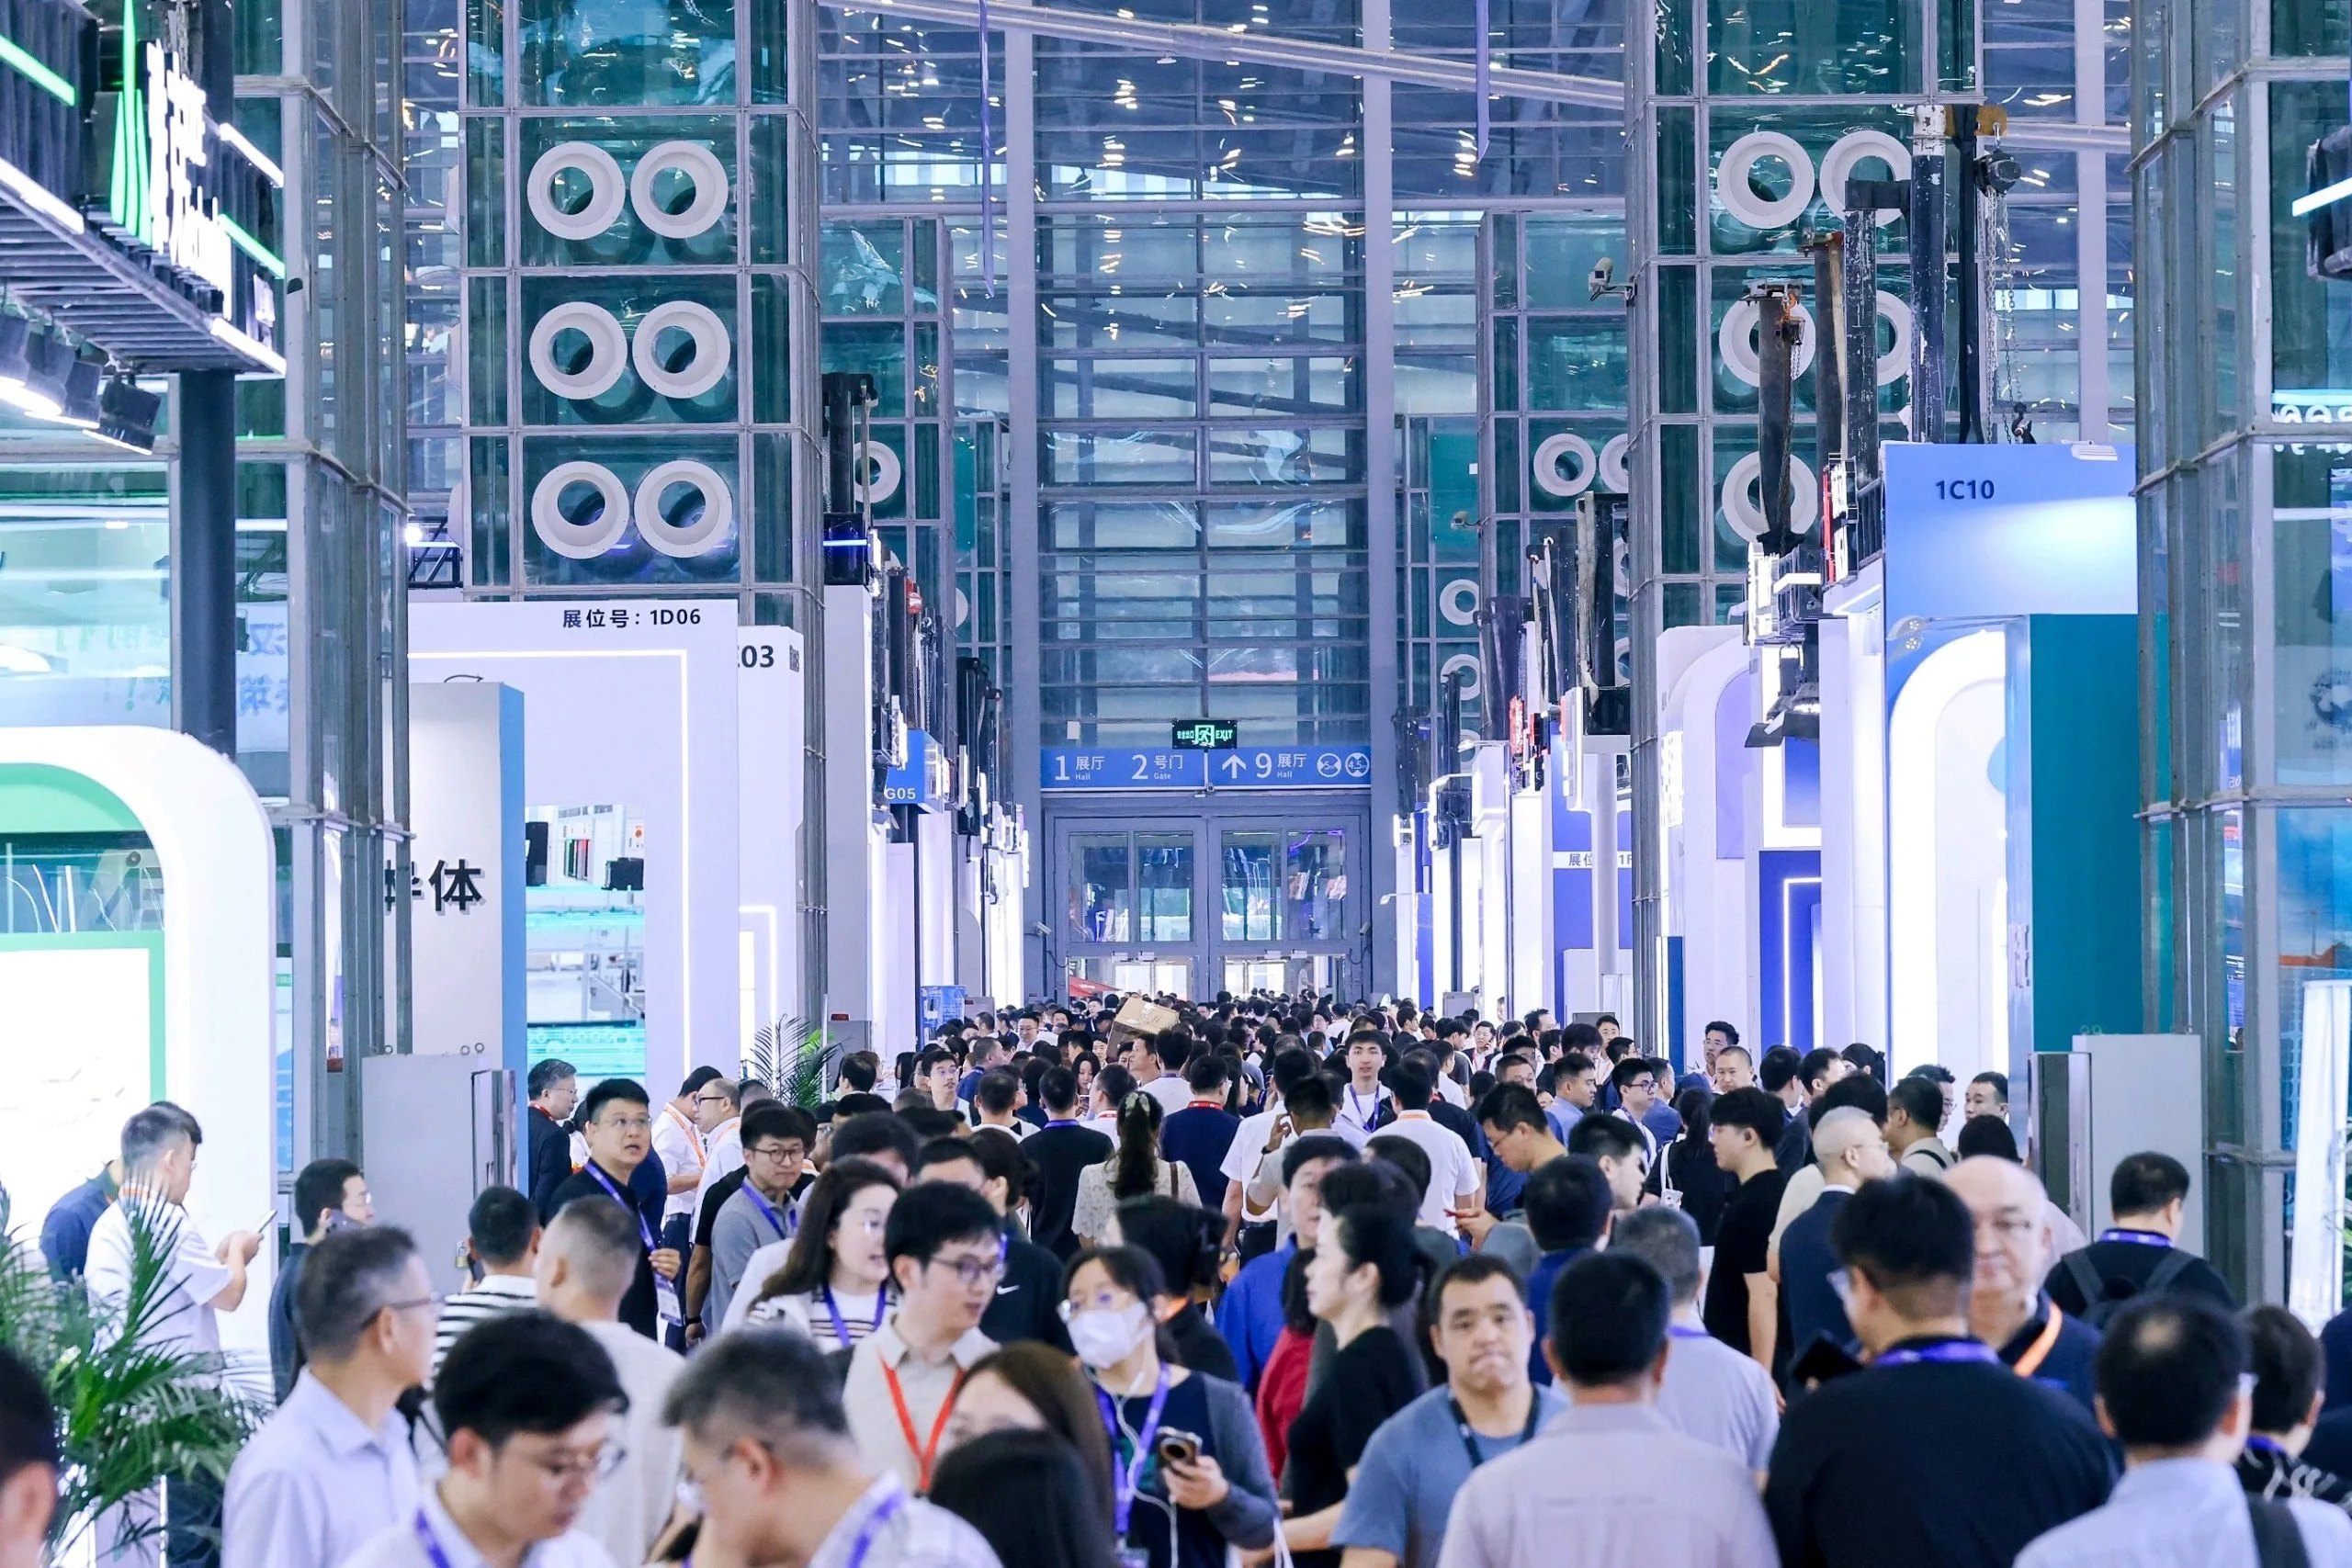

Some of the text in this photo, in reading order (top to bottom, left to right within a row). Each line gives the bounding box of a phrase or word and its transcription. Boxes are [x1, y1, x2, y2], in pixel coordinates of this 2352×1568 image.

[1936, 479, 1995, 500] 1C10
[738, 645, 775, 668] 03
[1216, 729, 1233, 739] EXIT
[1055, 755, 1070, 781] 1
[1075, 756, 1105, 771] 展厅
[1131, 754, 1148, 780] 2
[1154, 754, 1183, 770] 号门
[1255, 752, 1272, 778] 9
[1277, 753, 1307, 768] 展厅
